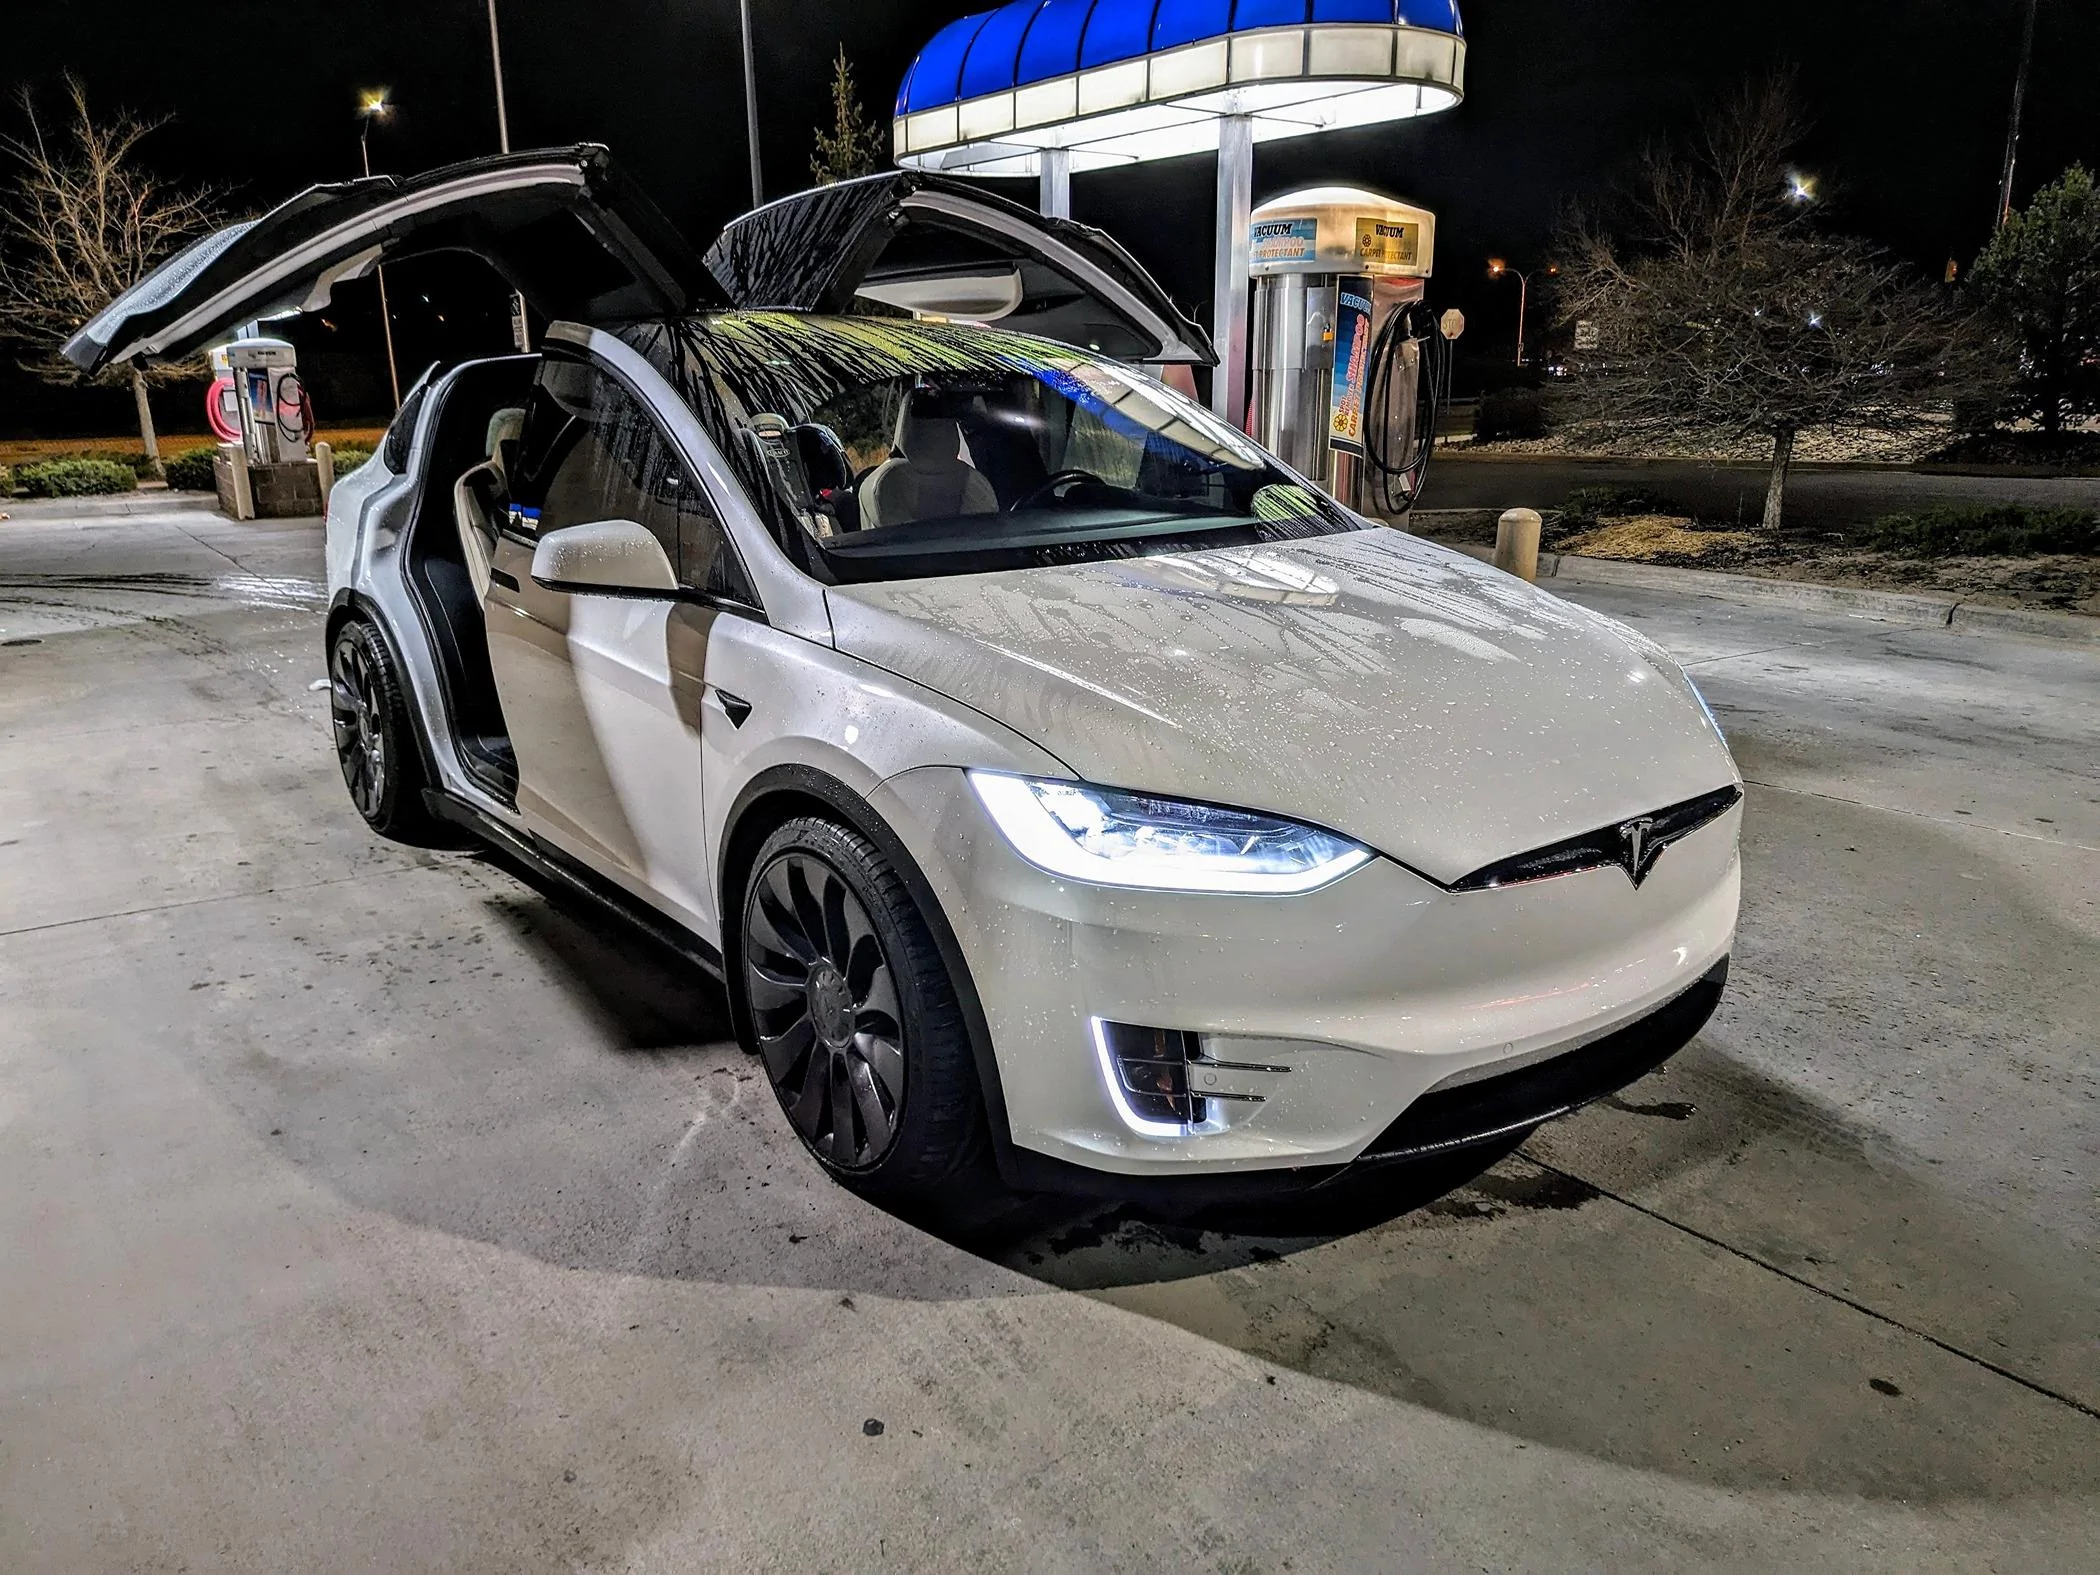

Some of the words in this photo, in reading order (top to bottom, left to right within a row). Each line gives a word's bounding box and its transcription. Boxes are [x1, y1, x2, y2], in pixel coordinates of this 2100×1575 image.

[1254, 223, 1293, 237] VACUUM
[1259, 247, 1306, 258] PROTECTANT
[1338, 396, 1347, 413] SPOT
[1348, 395, 1360, 437] CARPET
